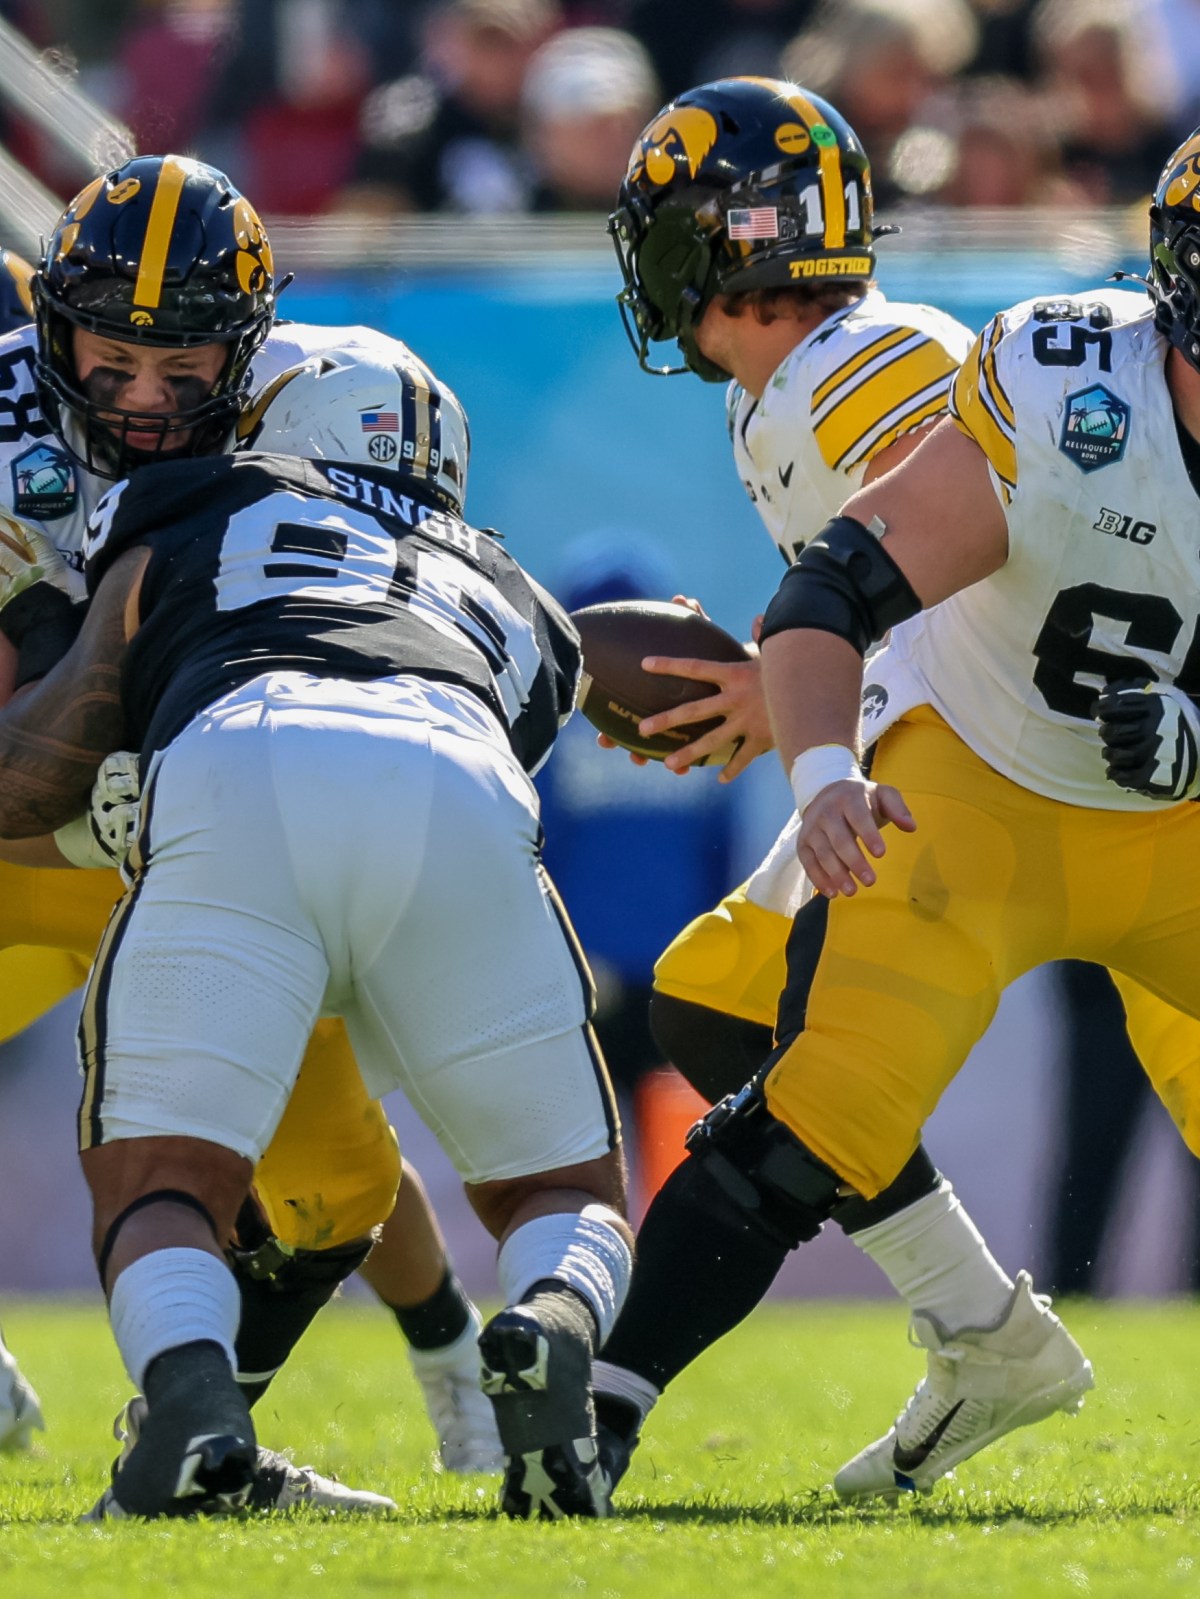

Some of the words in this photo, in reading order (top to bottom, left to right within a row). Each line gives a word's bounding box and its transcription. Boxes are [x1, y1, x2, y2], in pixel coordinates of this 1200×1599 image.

[371, 436, 397, 463] SEC
[1065, 440, 1113, 454] RELIAQUEST
[327, 467, 480, 560] SINGH
